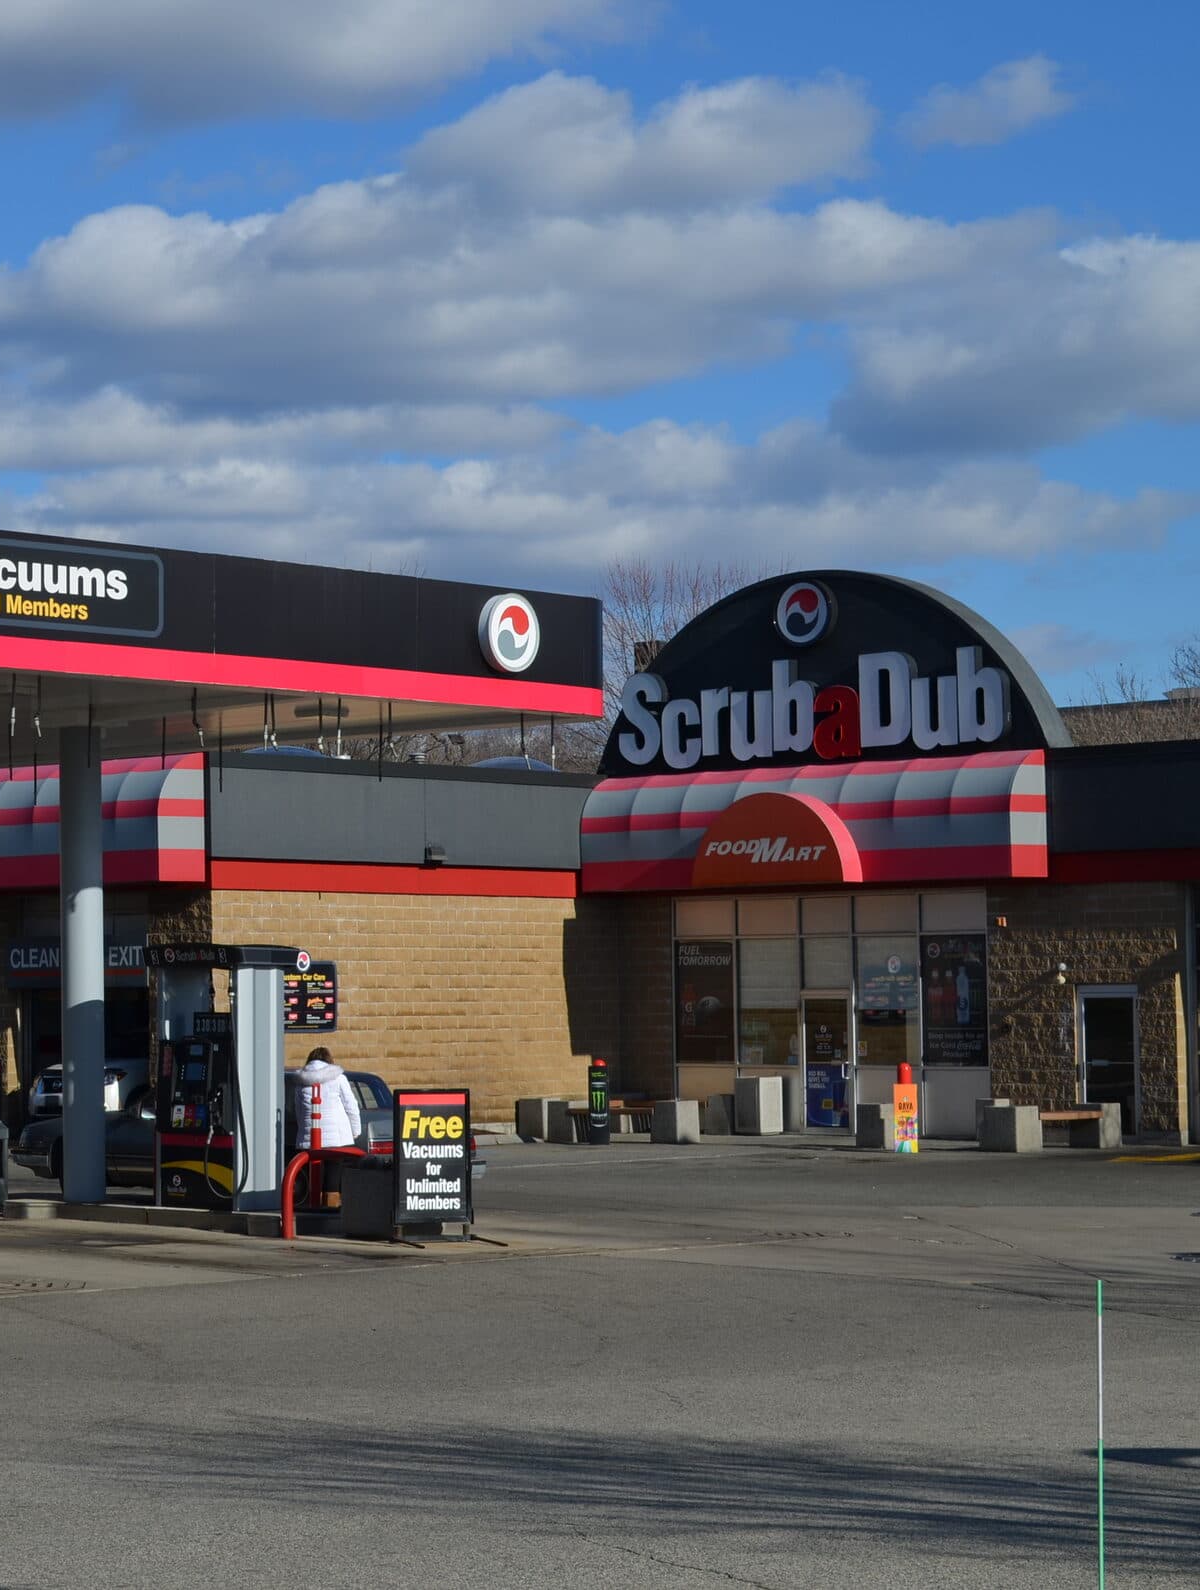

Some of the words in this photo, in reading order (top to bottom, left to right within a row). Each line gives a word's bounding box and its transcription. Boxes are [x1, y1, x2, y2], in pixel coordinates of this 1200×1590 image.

[6, 595, 89, 621] Members
[9, 947, 60, 968] CLEAN
[108, 945, 145, 967] EXIT
[679, 945, 700, 955] FUEL
[678, 956, 731, 967] TOMORROW
[402, 1110, 464, 1138] Free
[402, 1142, 464, 1158] Vacuums
[426, 1162, 442, 1175] for
[406, 1178, 460, 1194] Unlimited
[406, 1195, 461, 1210] Members
